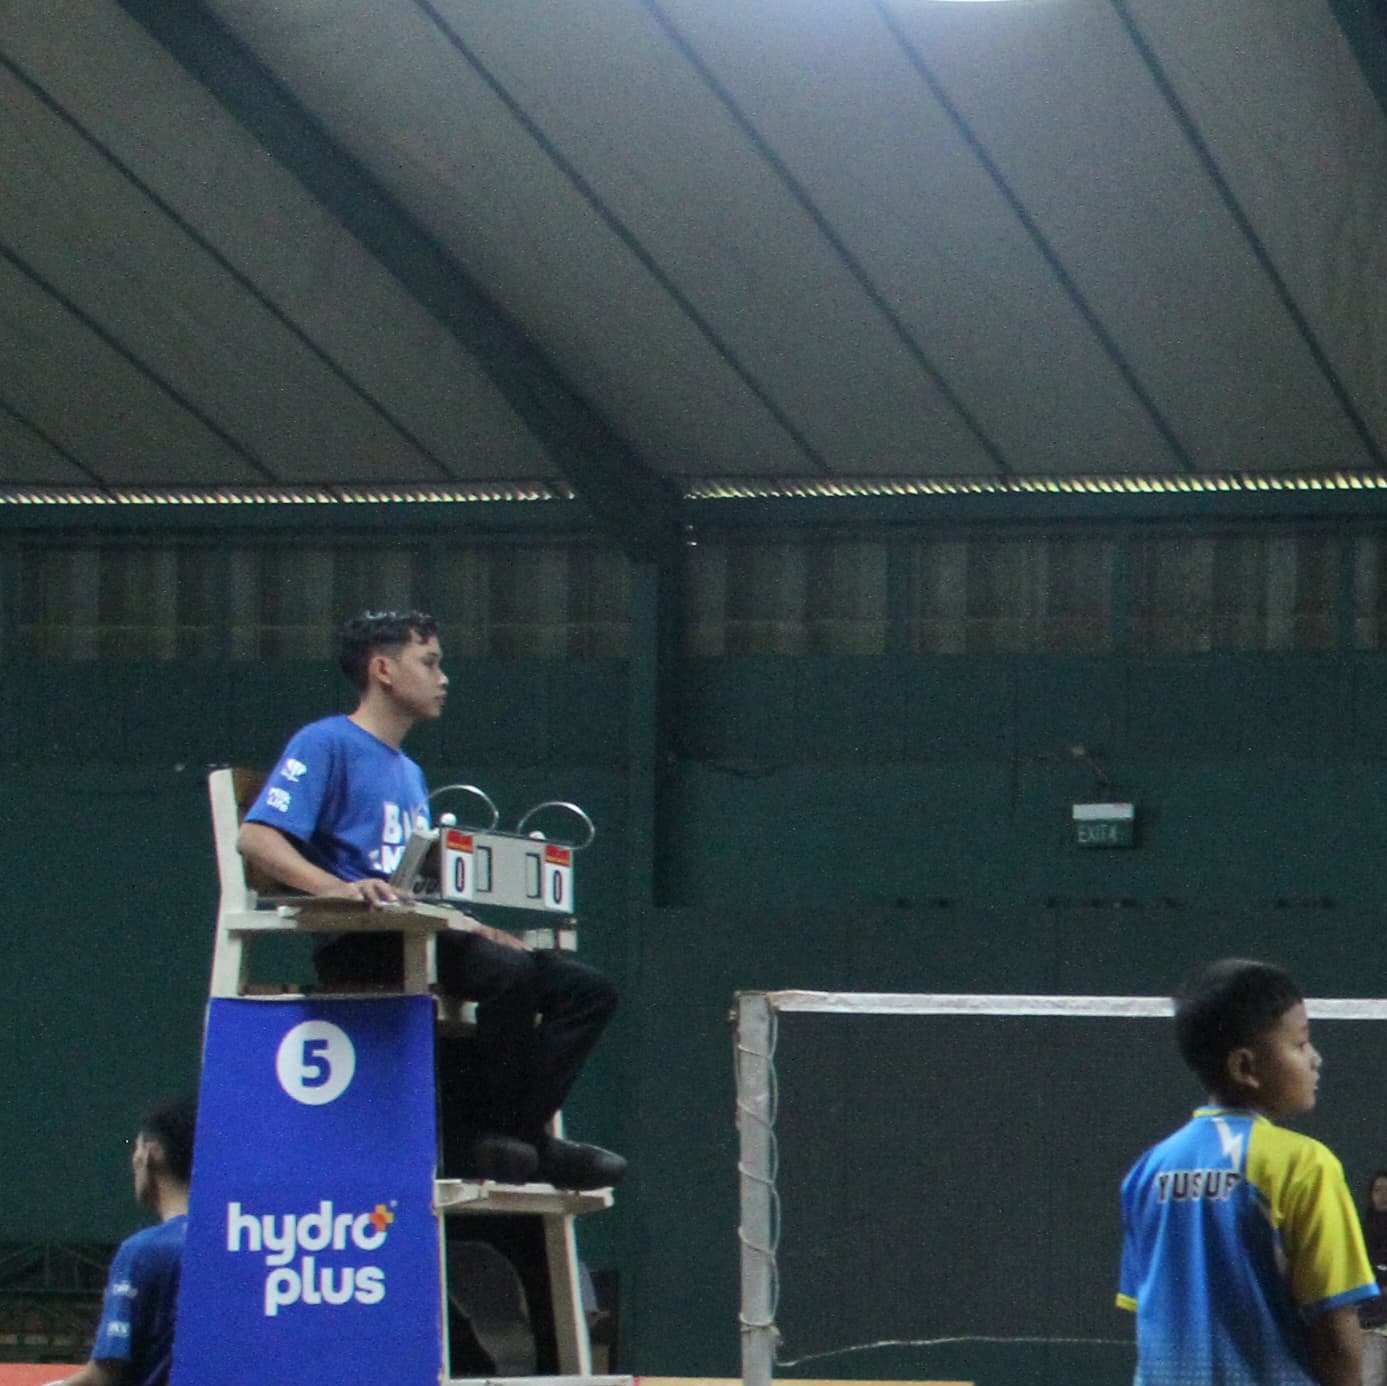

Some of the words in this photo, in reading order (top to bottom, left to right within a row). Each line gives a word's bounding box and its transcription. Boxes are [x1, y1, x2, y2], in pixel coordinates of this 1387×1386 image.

[454, 856, 466, 893] 0
[552, 869, 563, 905] 0
[301, 1038, 332, 1088] 5
[1157, 1169, 1240, 1204] YUSUF
[227, 1200, 390, 1267] hydro
[264, 1256, 386, 1317] plus
